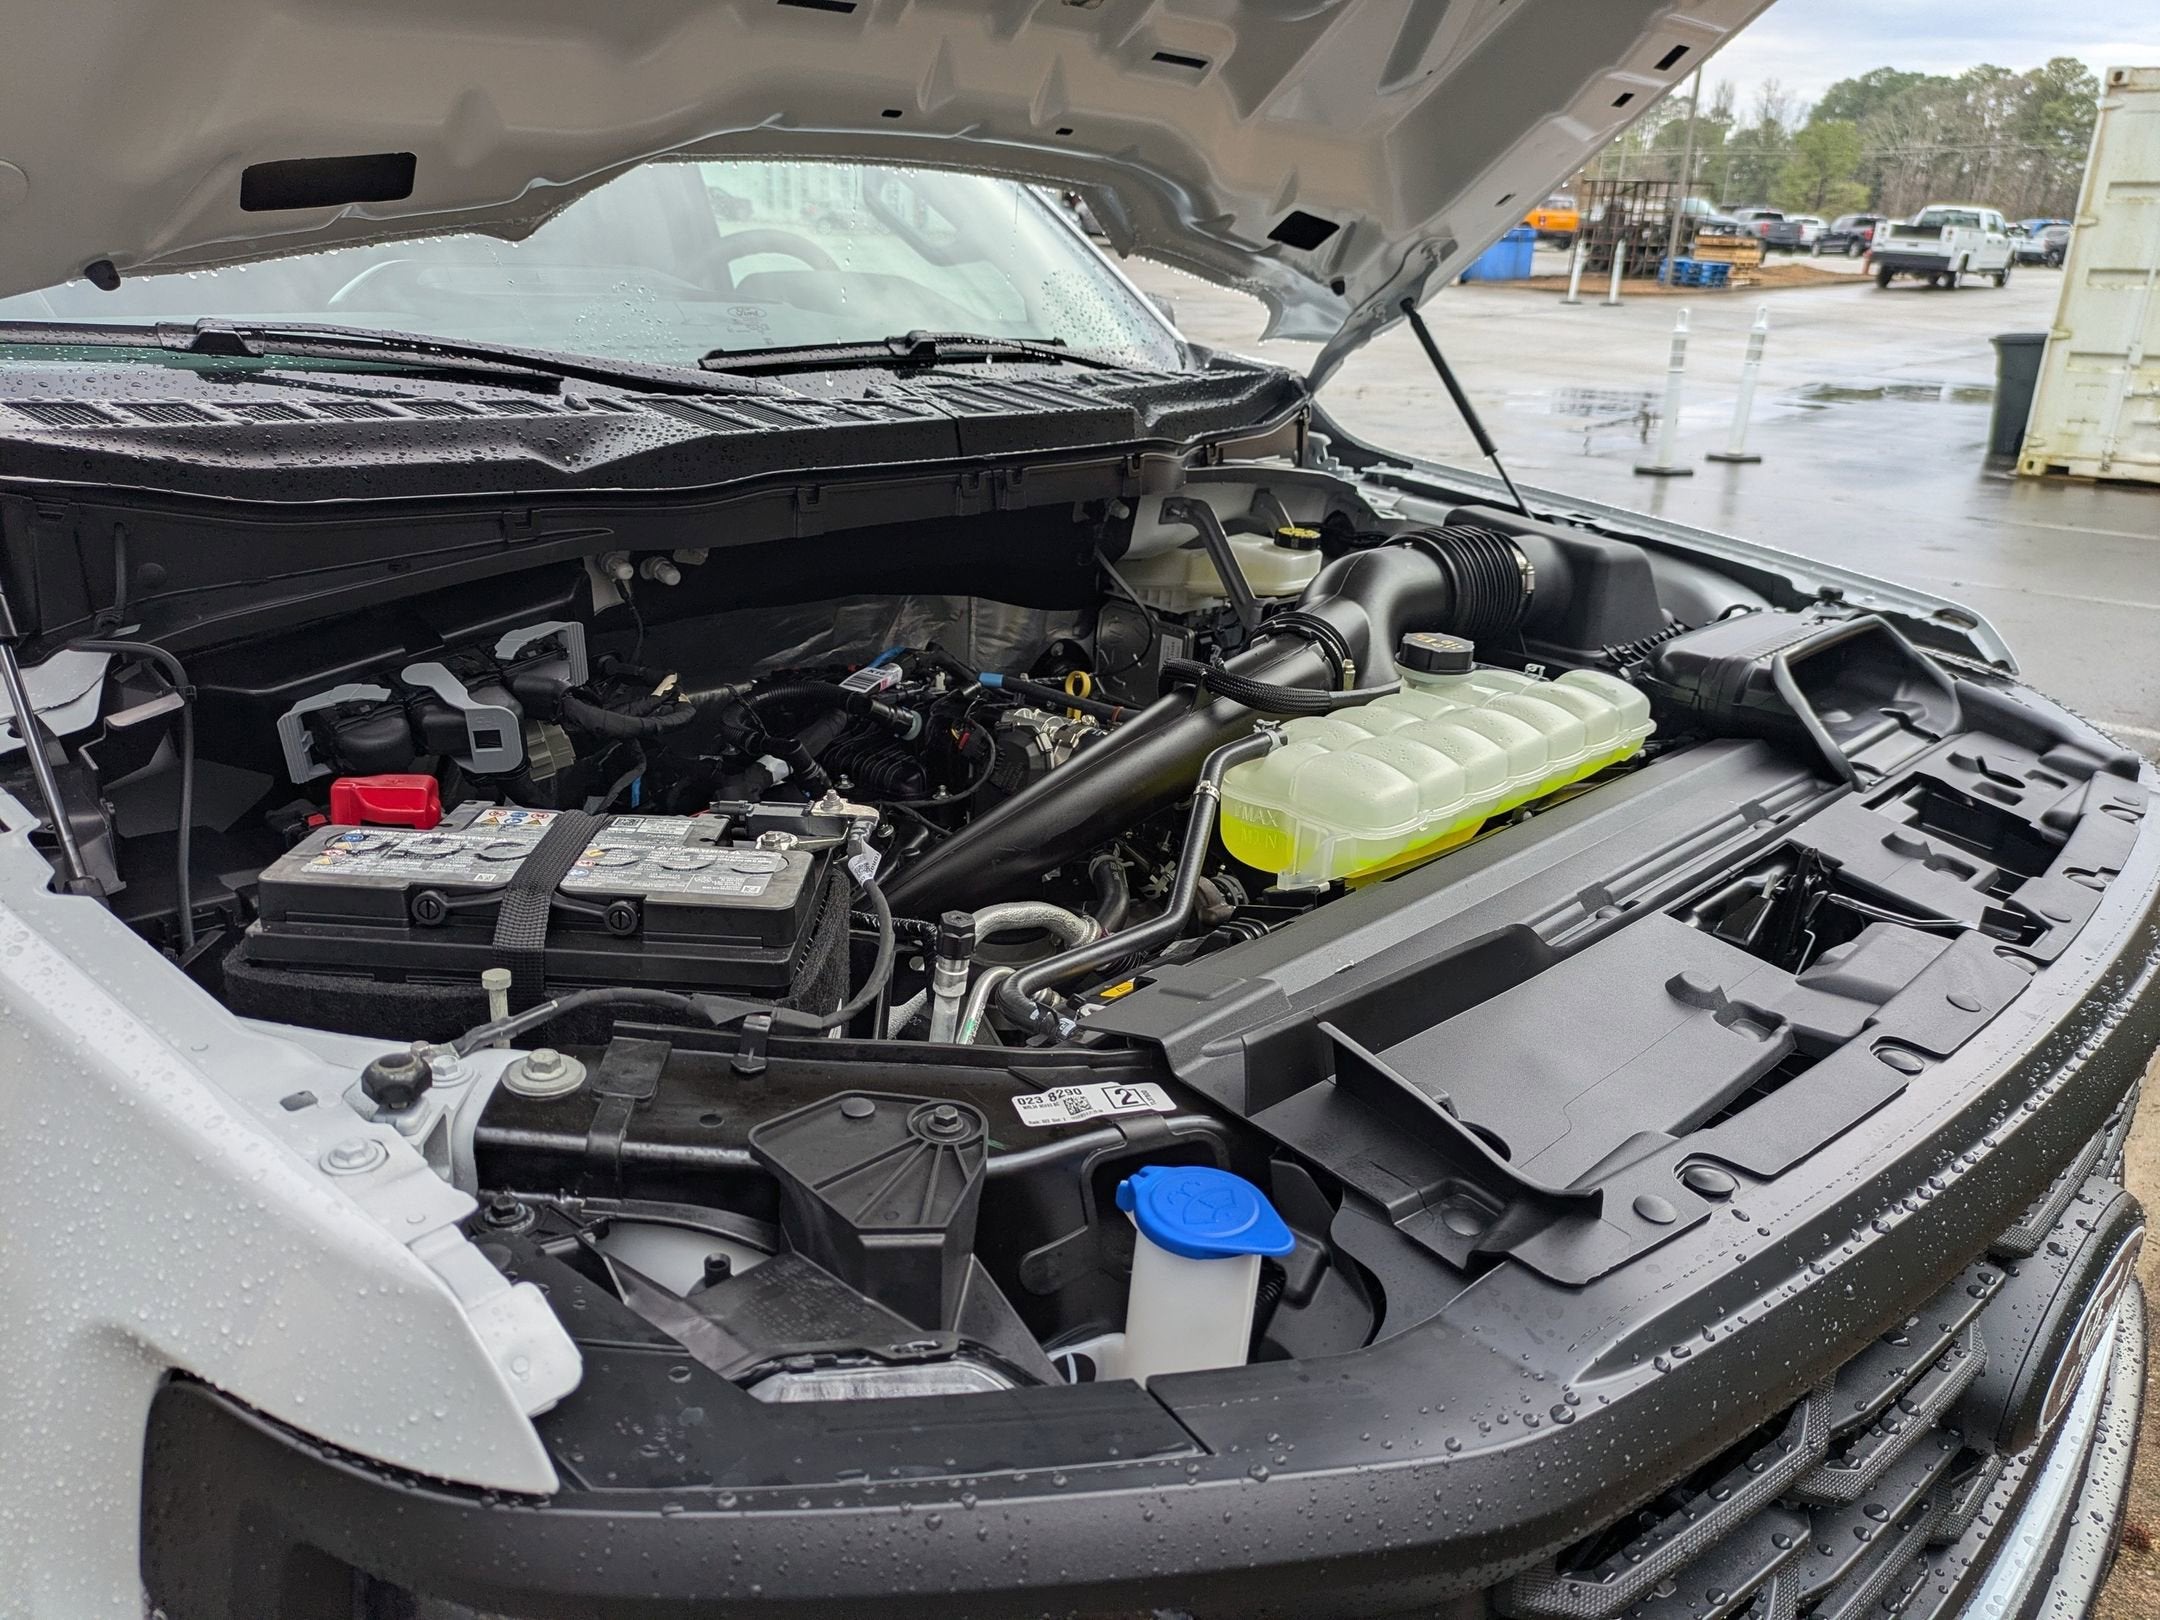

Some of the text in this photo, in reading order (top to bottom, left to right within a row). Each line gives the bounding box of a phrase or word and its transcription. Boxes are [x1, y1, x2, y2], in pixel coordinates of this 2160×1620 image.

[1016, 1087, 1083, 1106] 023 8290
[1115, 1088, 1139, 1105] 2
